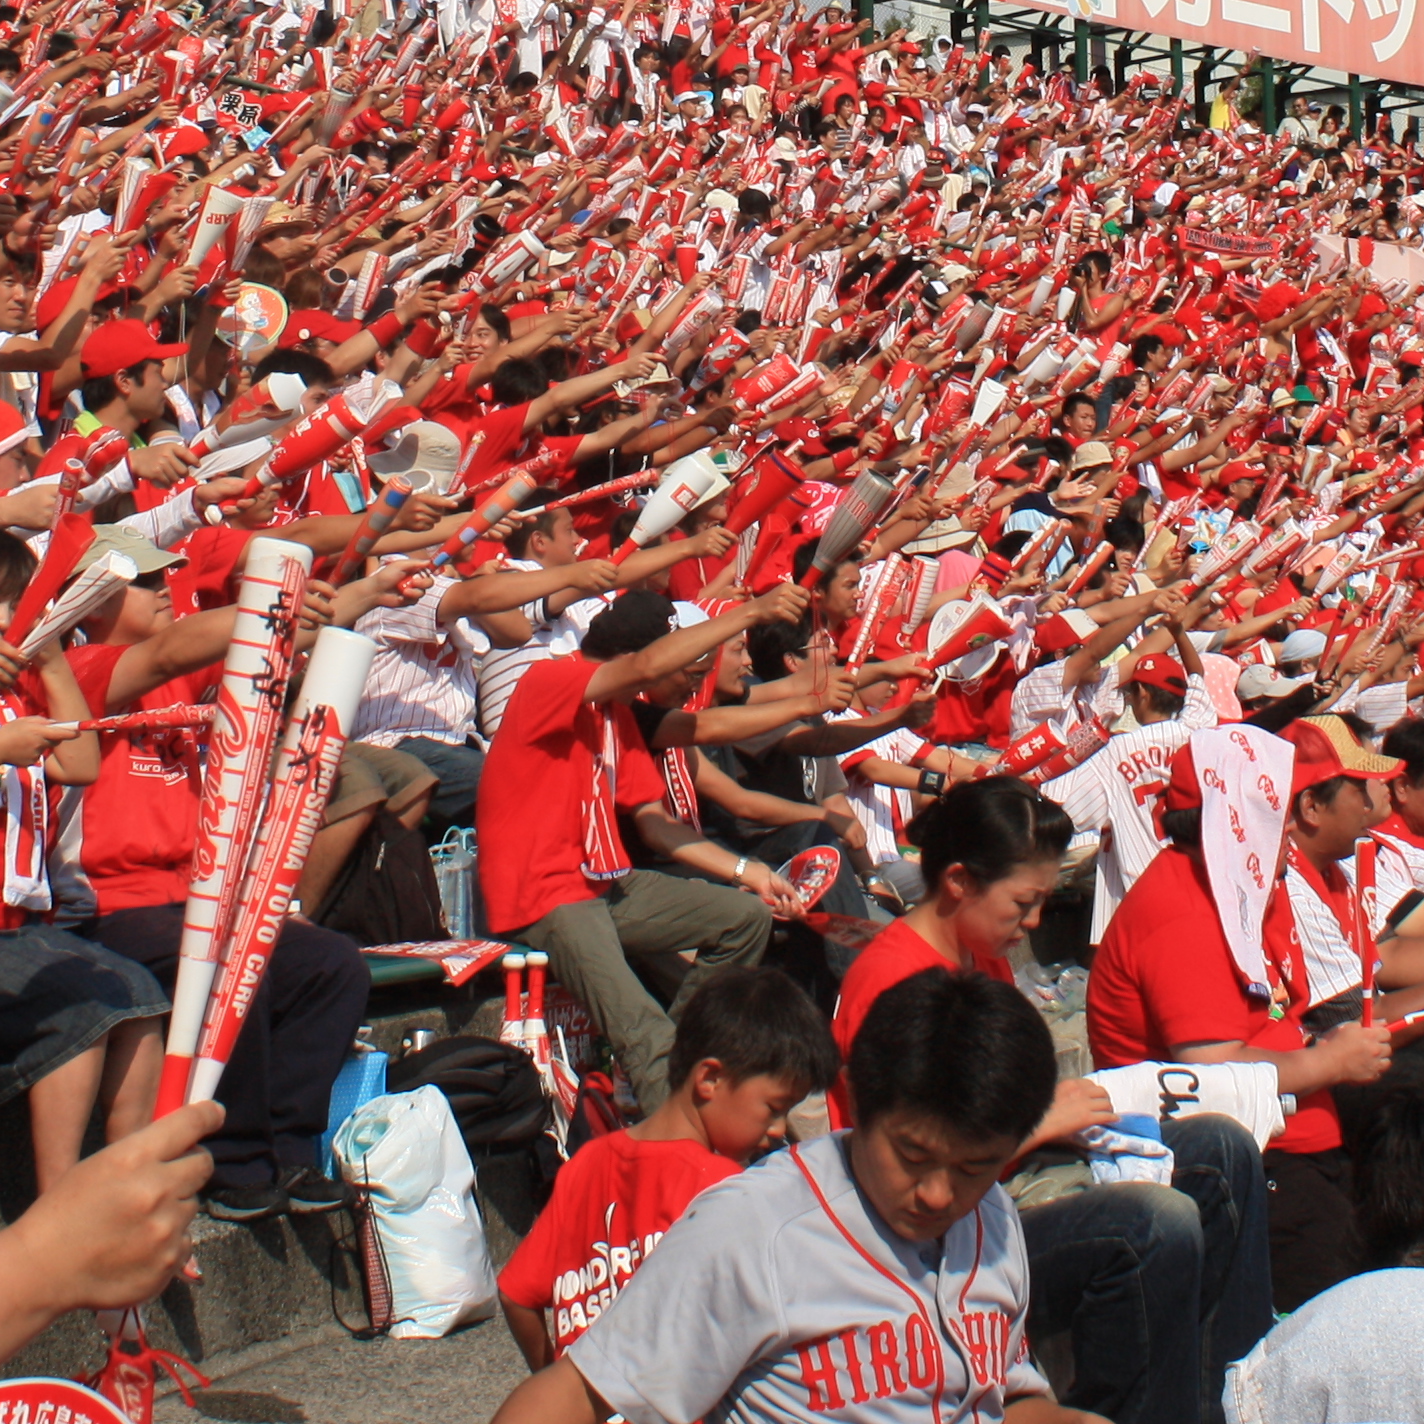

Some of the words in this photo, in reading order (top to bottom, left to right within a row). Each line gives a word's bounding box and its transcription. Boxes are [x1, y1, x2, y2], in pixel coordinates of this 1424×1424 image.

[190, 685, 250, 885] Carp
[281, 734, 348, 872] HIROSHIMA
[254, 881, 298, 947] TOYO
[230, 952, 266, 1020] CARP
